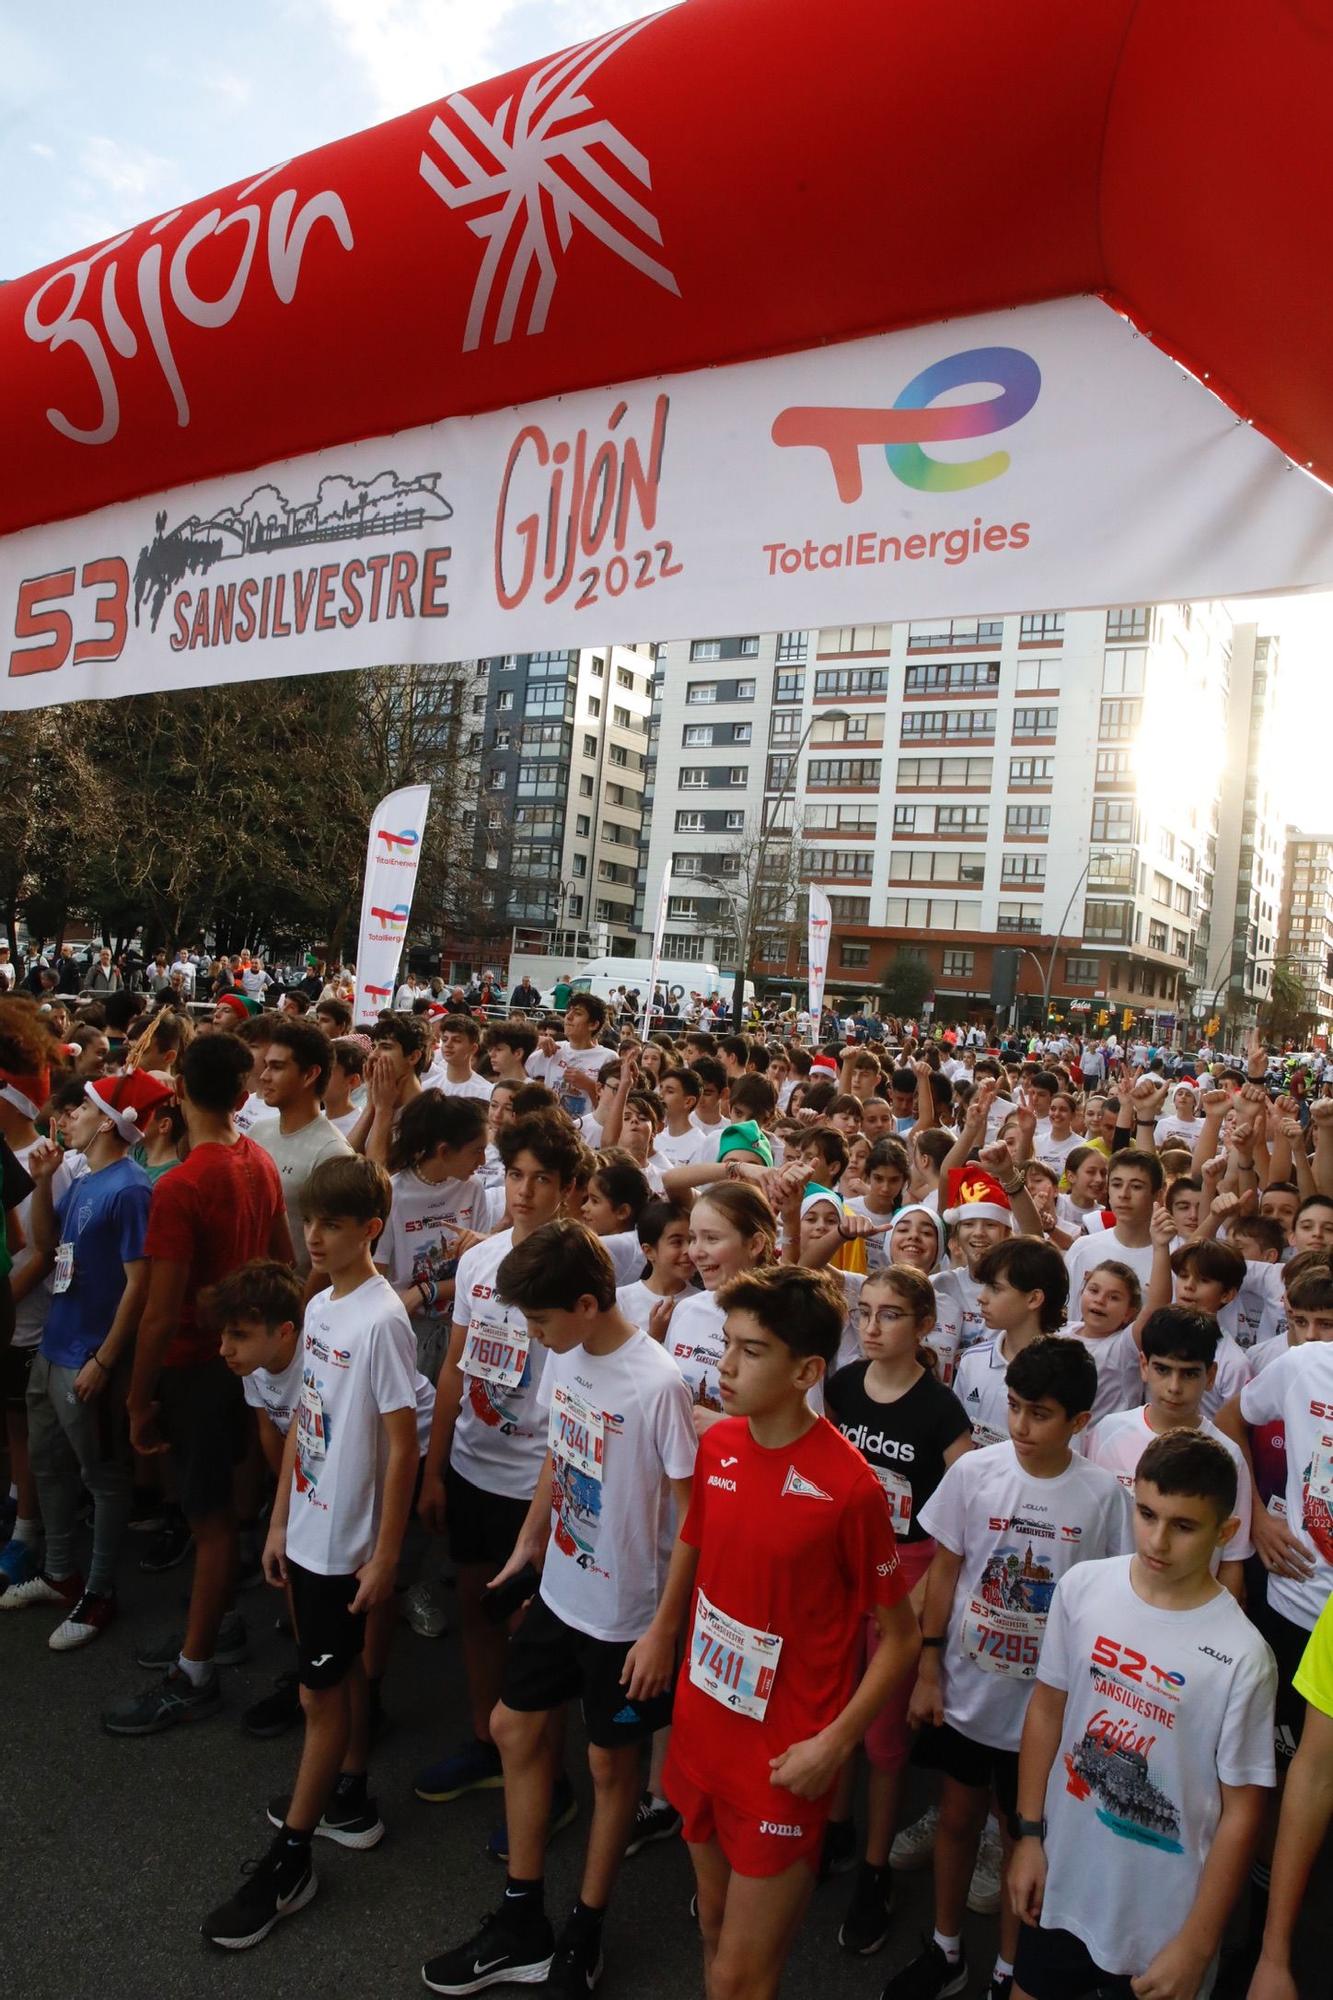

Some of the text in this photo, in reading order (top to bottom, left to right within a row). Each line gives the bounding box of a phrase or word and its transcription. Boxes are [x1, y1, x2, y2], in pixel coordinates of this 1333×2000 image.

[762, 517, 1032, 578] TotalEnergies
[573, 540, 684, 610] 2022
[8, 546, 453, 678] 53 SANSILVESTRE
[405, 1219, 423, 1232] 53
[471, 1283, 493, 1300] 53
[470, 1335, 515, 1370] 7607
[674, 1342, 693, 1359] 53
[555, 1388, 567, 1405] 53
[560, 1410, 590, 1458] 7341
[838, 1421, 916, 1463] adidas
[706, 1474, 737, 1493] ABANCA
[988, 1517, 1056, 1540] 53 SANSILVESTRE
[970, 1600, 989, 1618] 53
[698, 1631, 745, 1691] 7411
[976, 1623, 1039, 1665] 7295
[1090, 1635, 1149, 1684] 52
[1093, 1675, 1176, 1730] SANSILVESTRE
[760, 1820, 803, 1838] Joma
